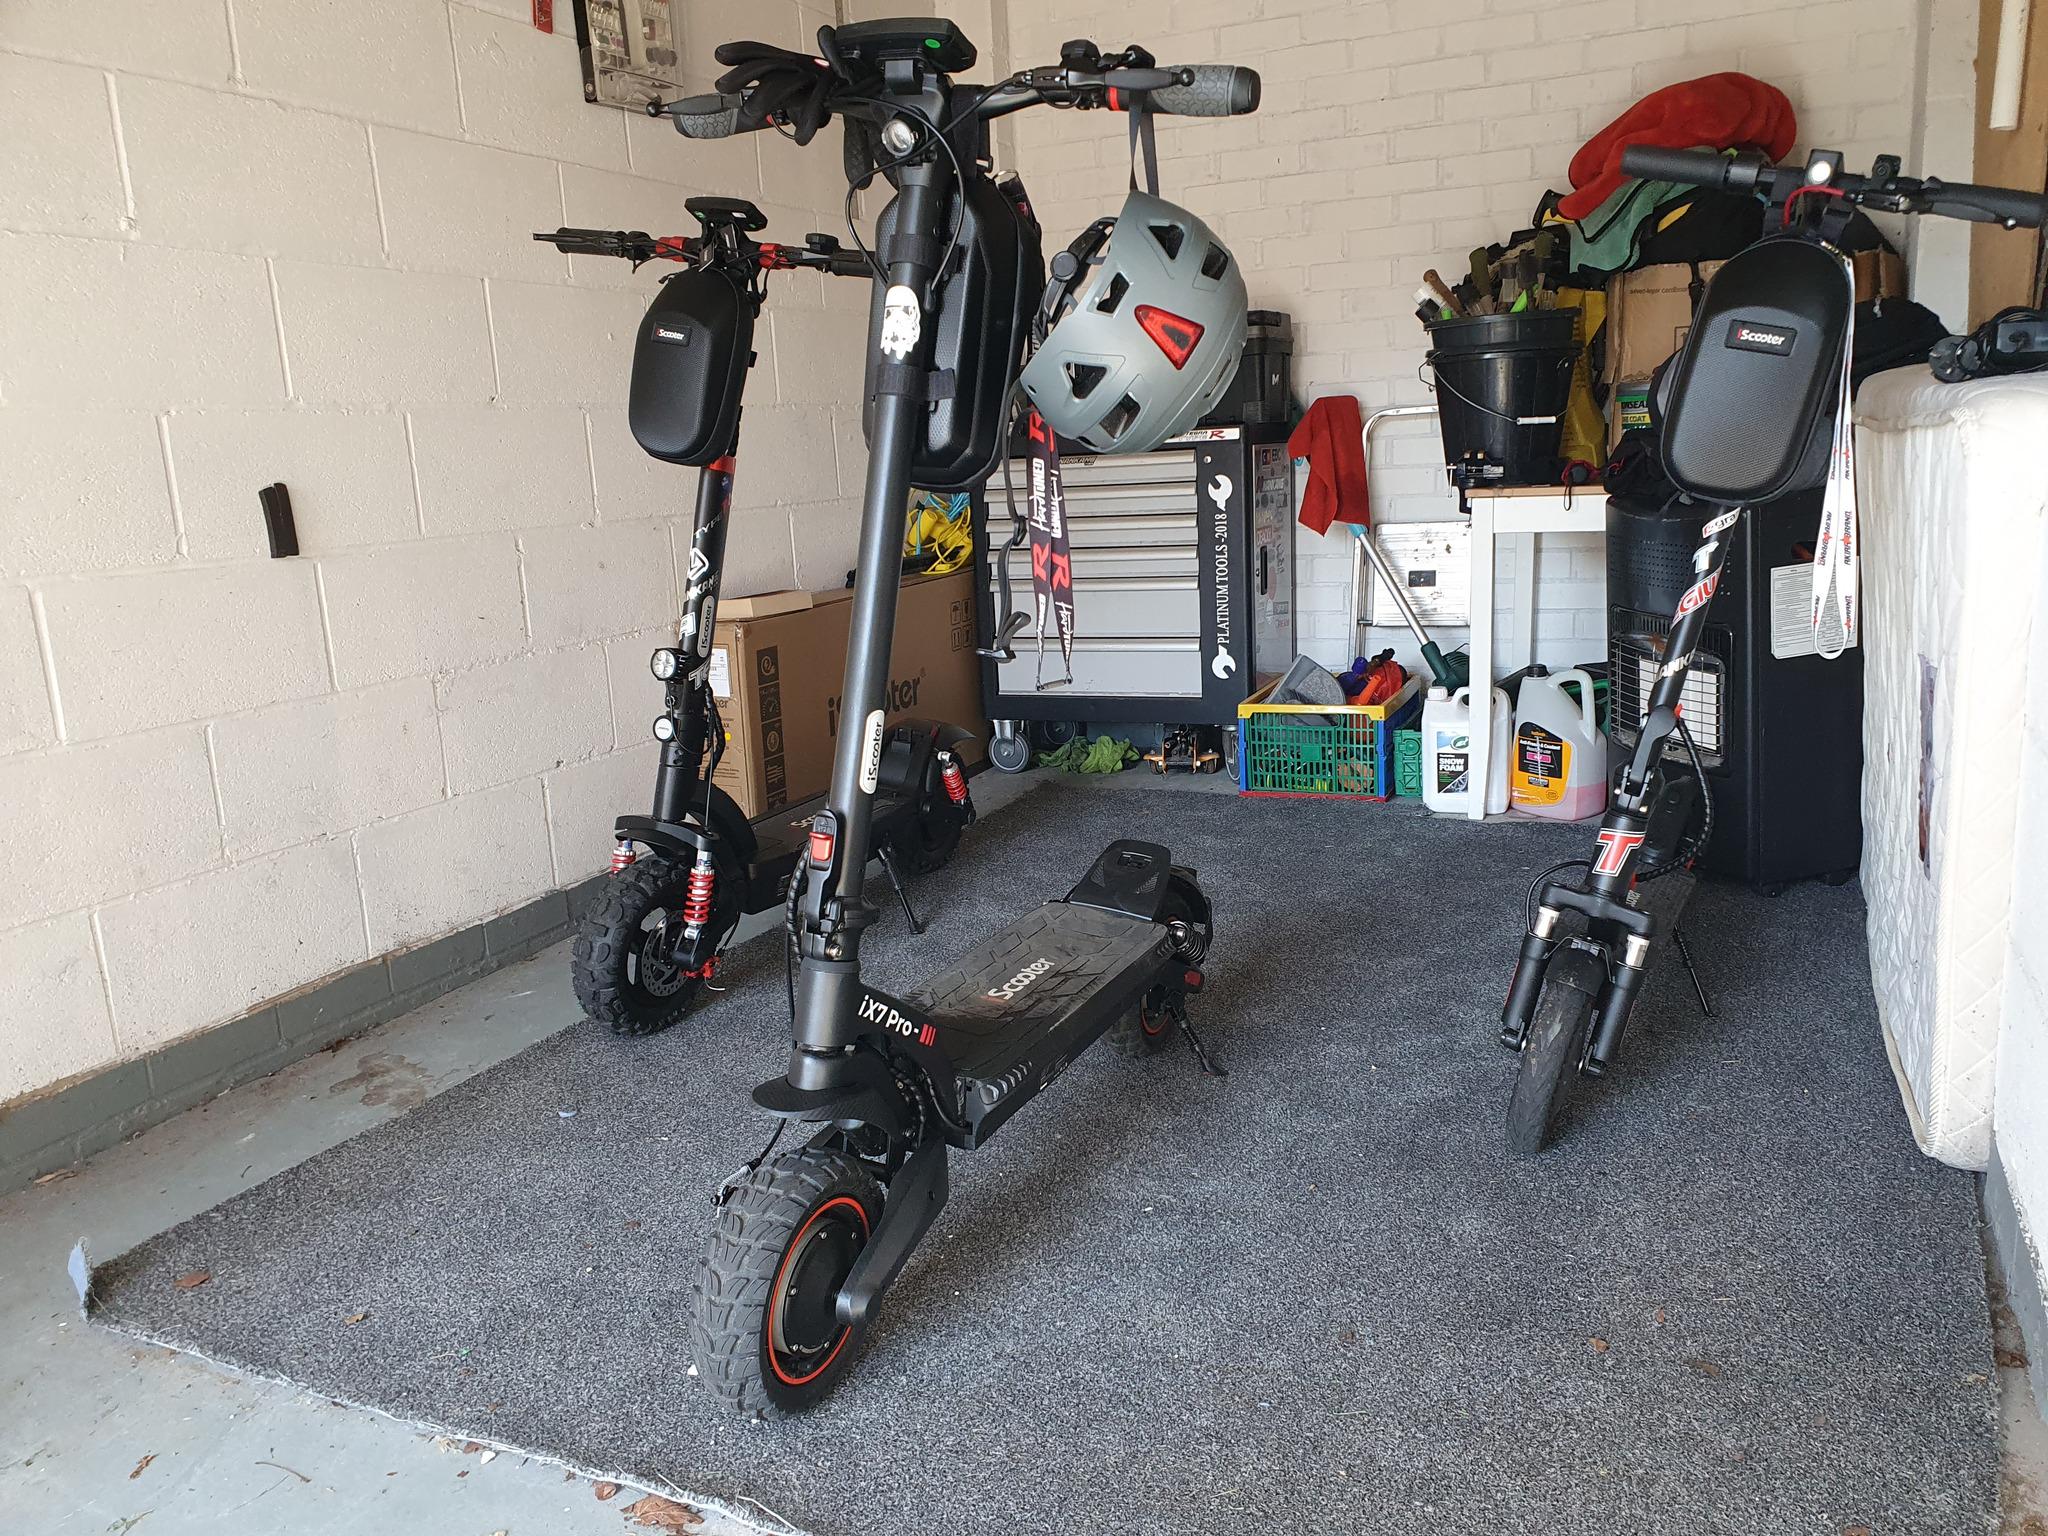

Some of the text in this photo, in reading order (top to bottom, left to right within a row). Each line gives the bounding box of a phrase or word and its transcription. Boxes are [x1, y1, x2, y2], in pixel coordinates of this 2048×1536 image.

[1216, 584, 1230, 644] PLATINUM
[867, 721, 883, 781] iScooter
[1439, 764, 1464, 772] FOAM
[1592, 827, 1647, 877] T
[857, 994, 889, 1024] iX7
